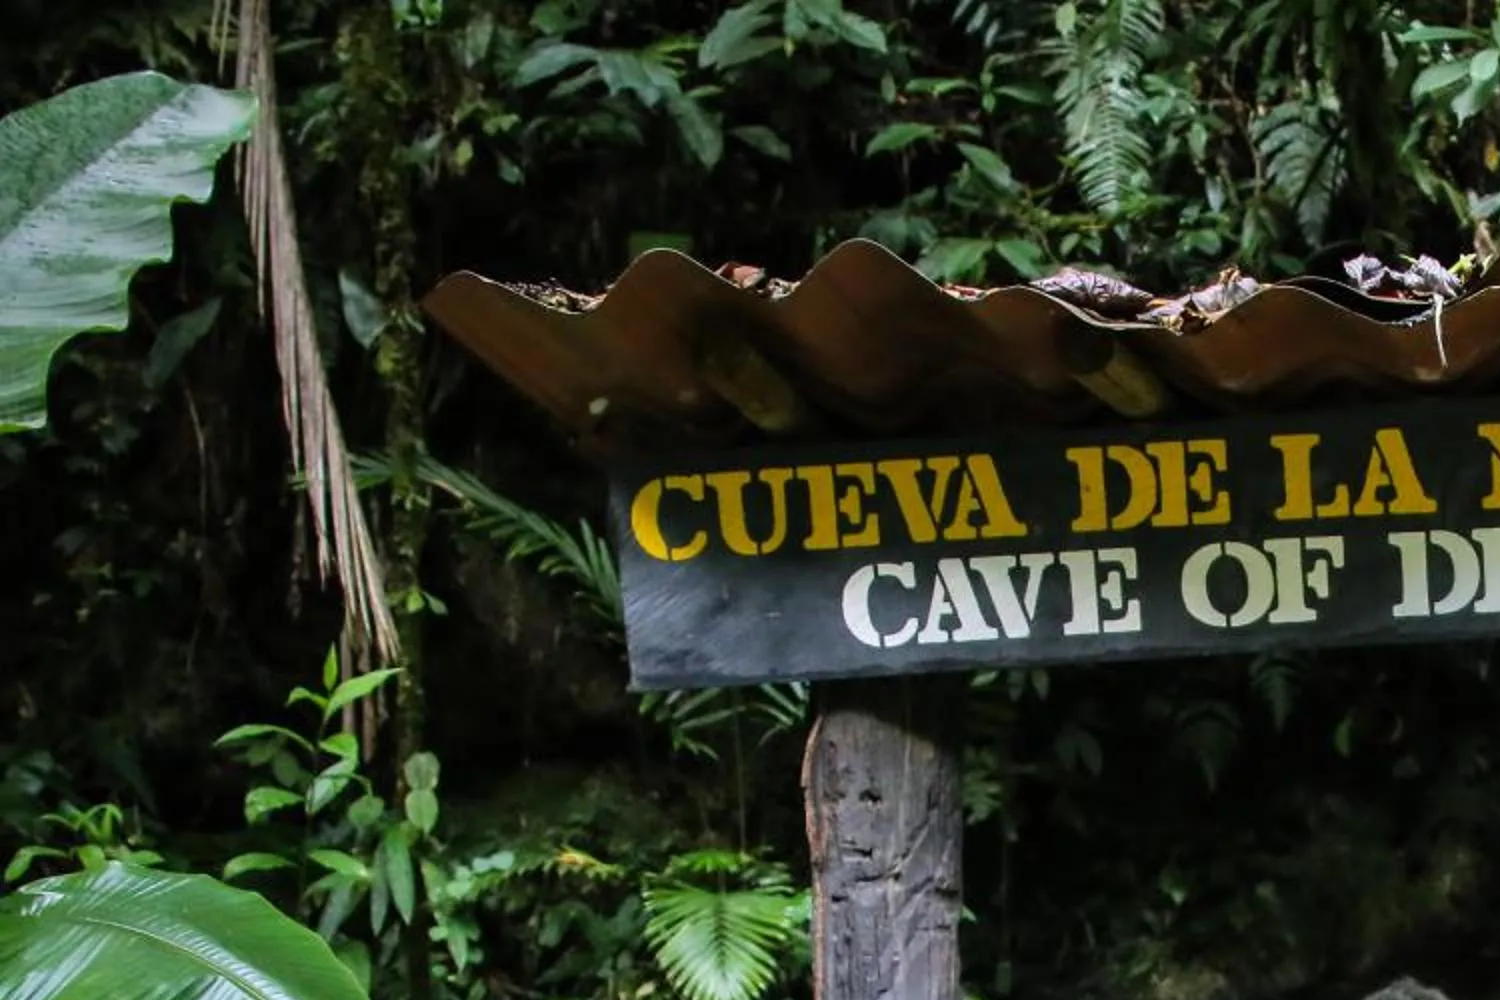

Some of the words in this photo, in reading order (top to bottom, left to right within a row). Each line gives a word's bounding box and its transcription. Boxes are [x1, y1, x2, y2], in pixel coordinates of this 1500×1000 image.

[631, 455, 1026, 561] CUEVA
[1067, 440, 1230, 531] DE
[1271, 429, 1436, 519] LA
[842, 548, 1141, 648] CAVE
[1182, 536, 1344, 627] OF
